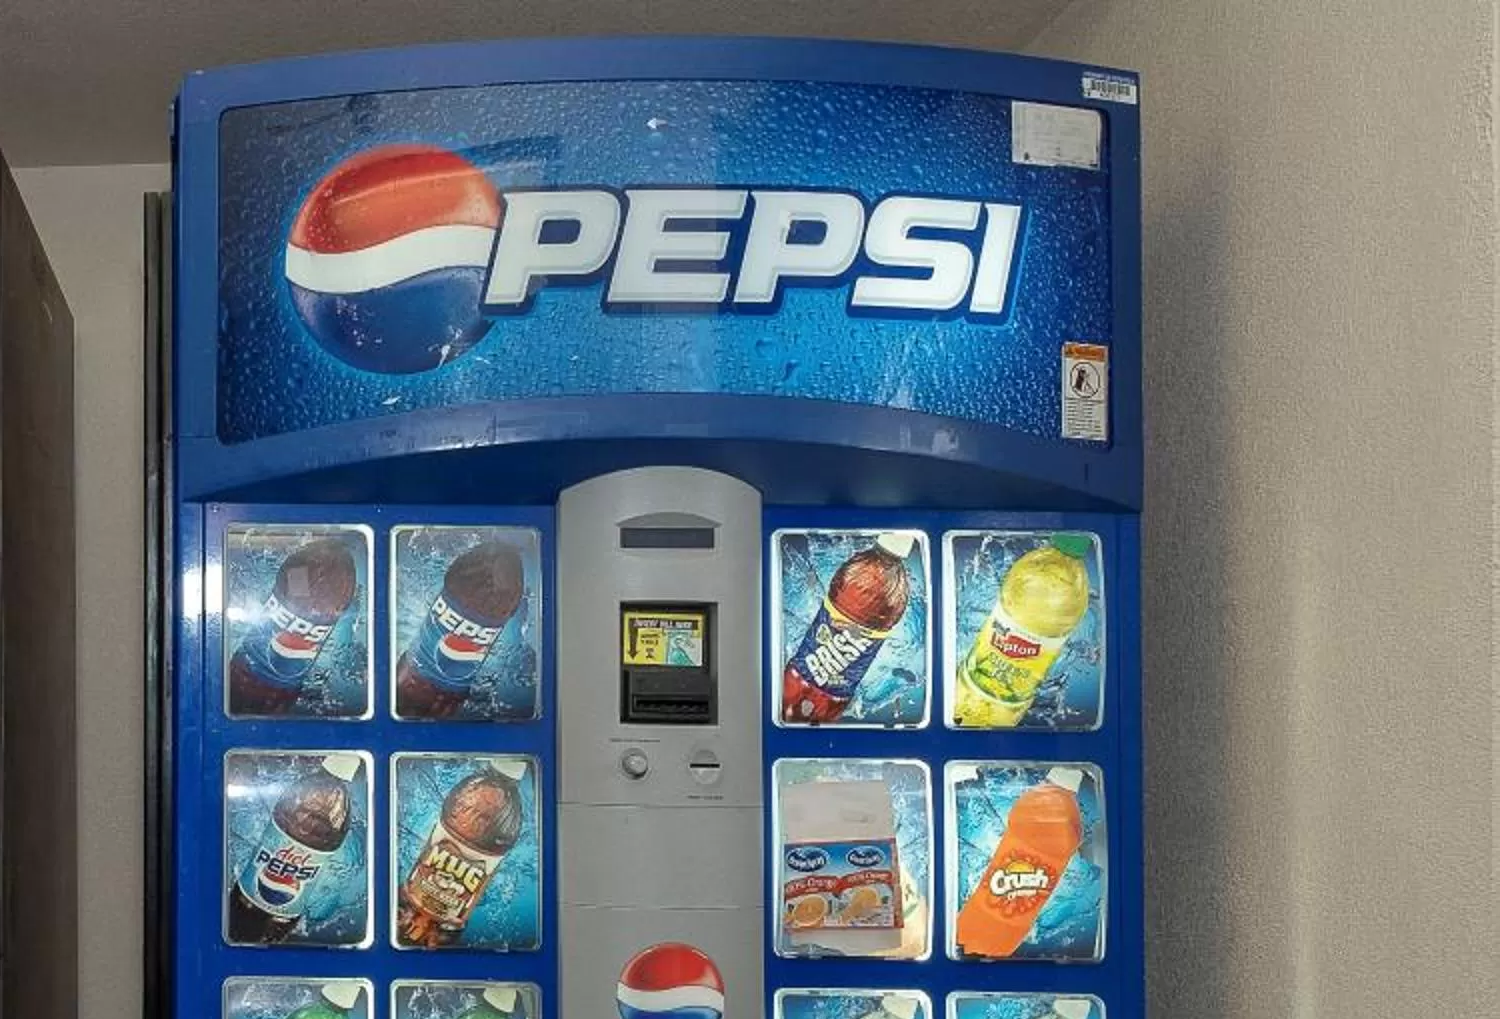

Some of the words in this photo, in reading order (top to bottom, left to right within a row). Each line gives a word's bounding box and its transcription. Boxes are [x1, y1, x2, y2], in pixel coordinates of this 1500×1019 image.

[483, 190, 1022, 315] PEPSI
[262, 593, 333, 643] PEPS
[432, 595, 503, 646] PEPS
[426, 845, 484, 893] MUG
[991, 868, 1049, 896] Crush
